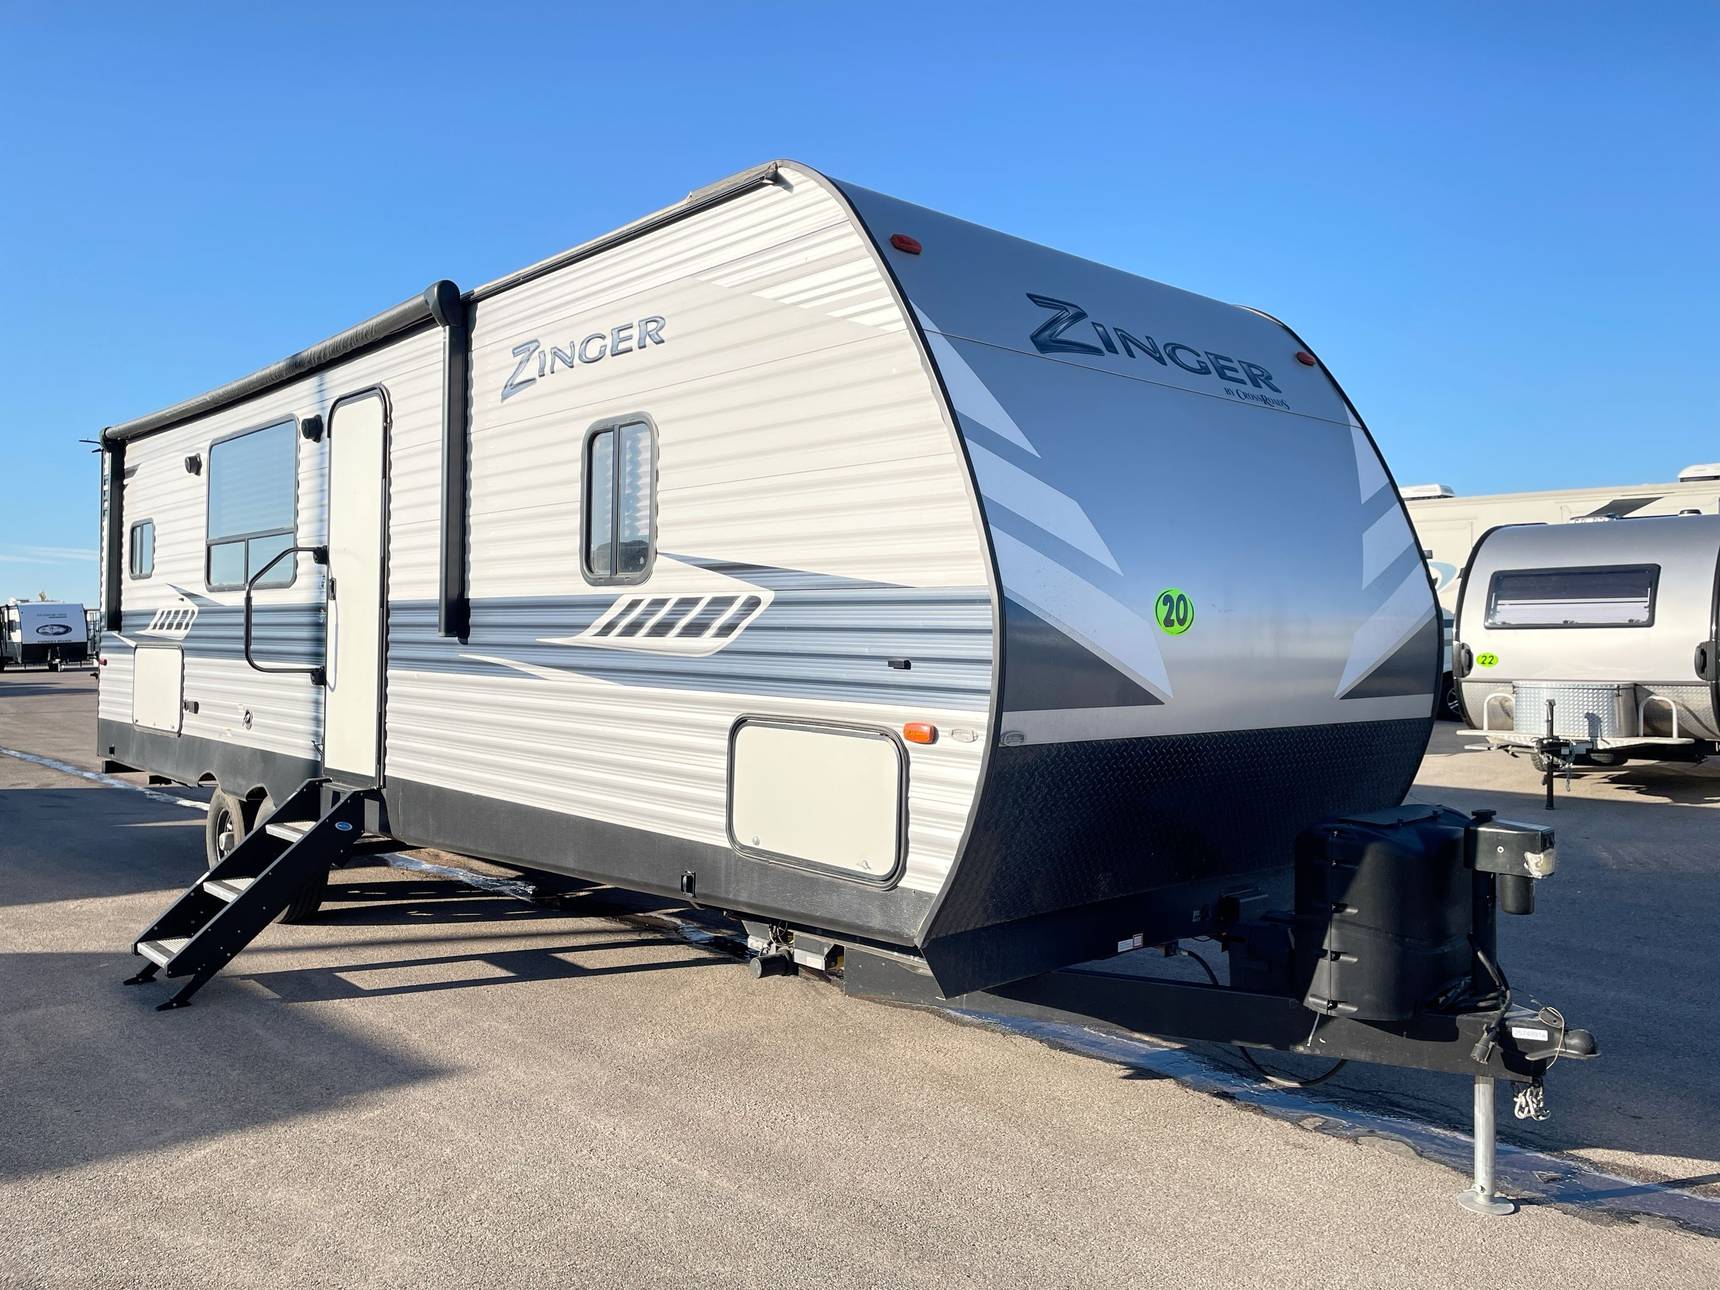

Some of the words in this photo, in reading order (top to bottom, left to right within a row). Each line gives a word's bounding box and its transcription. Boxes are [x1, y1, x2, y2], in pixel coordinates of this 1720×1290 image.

[501, 315, 666, 403] ZINGER
[1026, 292, 1282, 393] ZINGER
[1162, 593, 1189, 628] 20
[1480, 655, 1495, 665] 22
